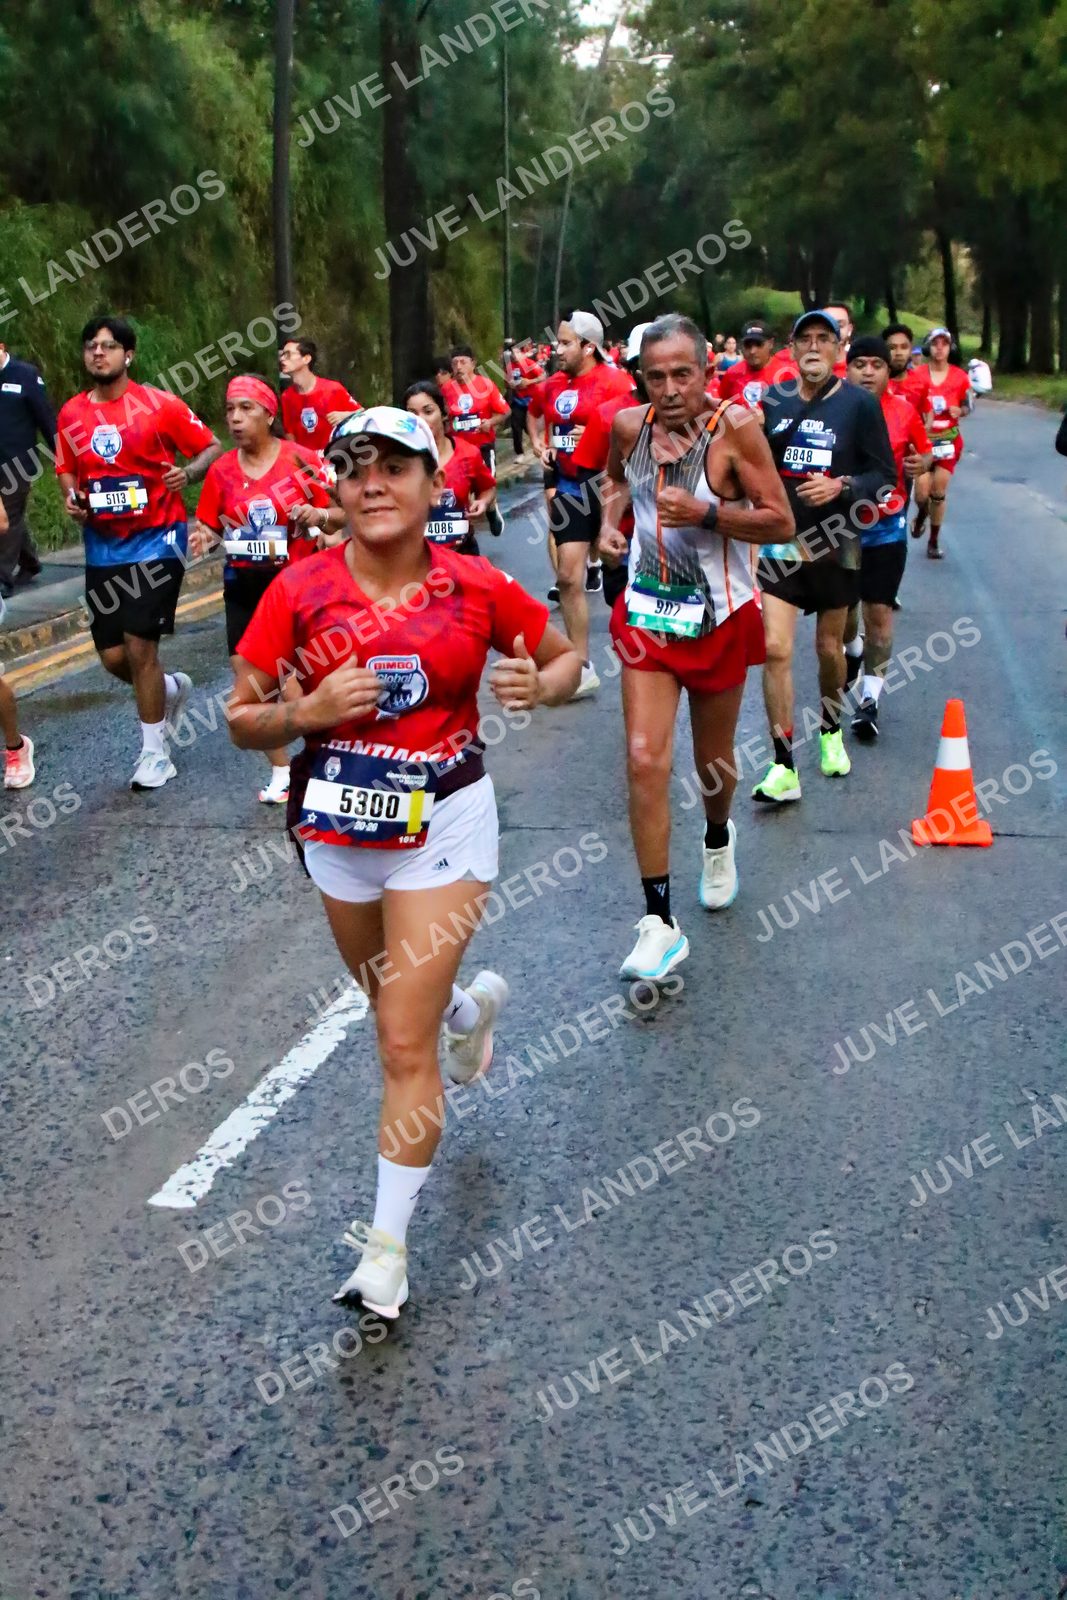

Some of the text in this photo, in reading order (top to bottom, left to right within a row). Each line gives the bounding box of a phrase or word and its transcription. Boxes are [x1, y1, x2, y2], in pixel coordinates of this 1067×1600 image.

[785, 448, 813, 462] 3848
[105, 492, 127, 505] 5113
[428, 522, 453, 534] 4086
[246, 541, 266, 554] 4111
[654, 599, 681, 616] 907
[374, 661, 413, 670] BIMBO
[339, 787, 400, 819] 5300
